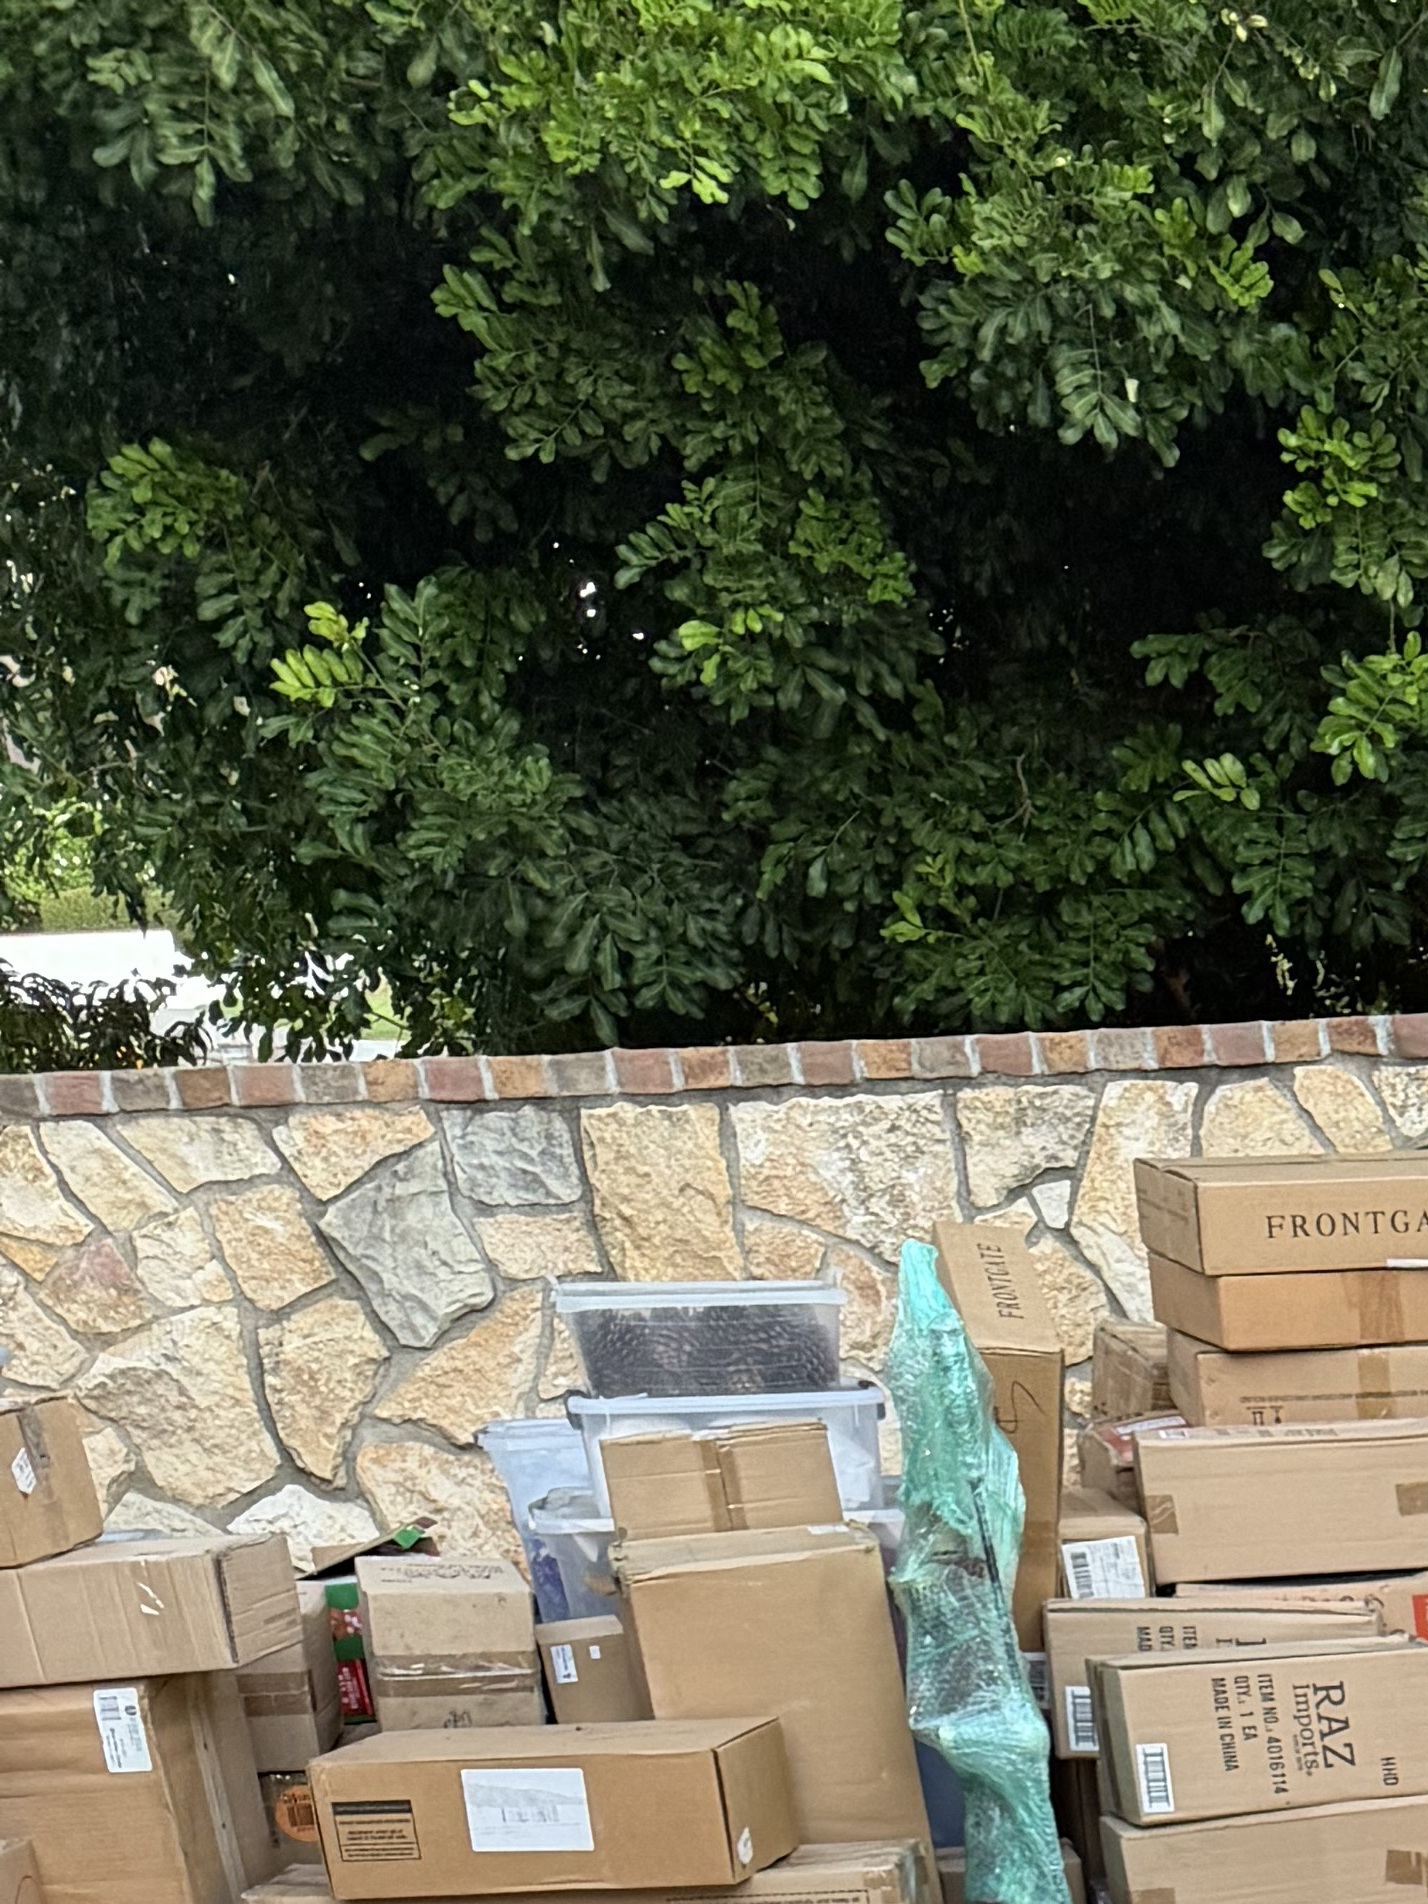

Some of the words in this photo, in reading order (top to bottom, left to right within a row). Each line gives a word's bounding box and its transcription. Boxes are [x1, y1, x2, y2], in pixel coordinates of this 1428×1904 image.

[986, 1242, 1024, 1320] FRONTGATE
[1137, 1626, 1151, 1651] MAD
[1211, 1677, 1230, 1712] MADE
[1216, 1716, 1232, 1731] IN
[1242, 1726, 1258, 1741] EA
[1256, 1674, 1274, 1703] ITEM
[1266, 1735, 1290, 1795] 4016114
[1313, 1680, 1357, 1769] RAZ
[1219, 1733, 1240, 1772] CHINA
